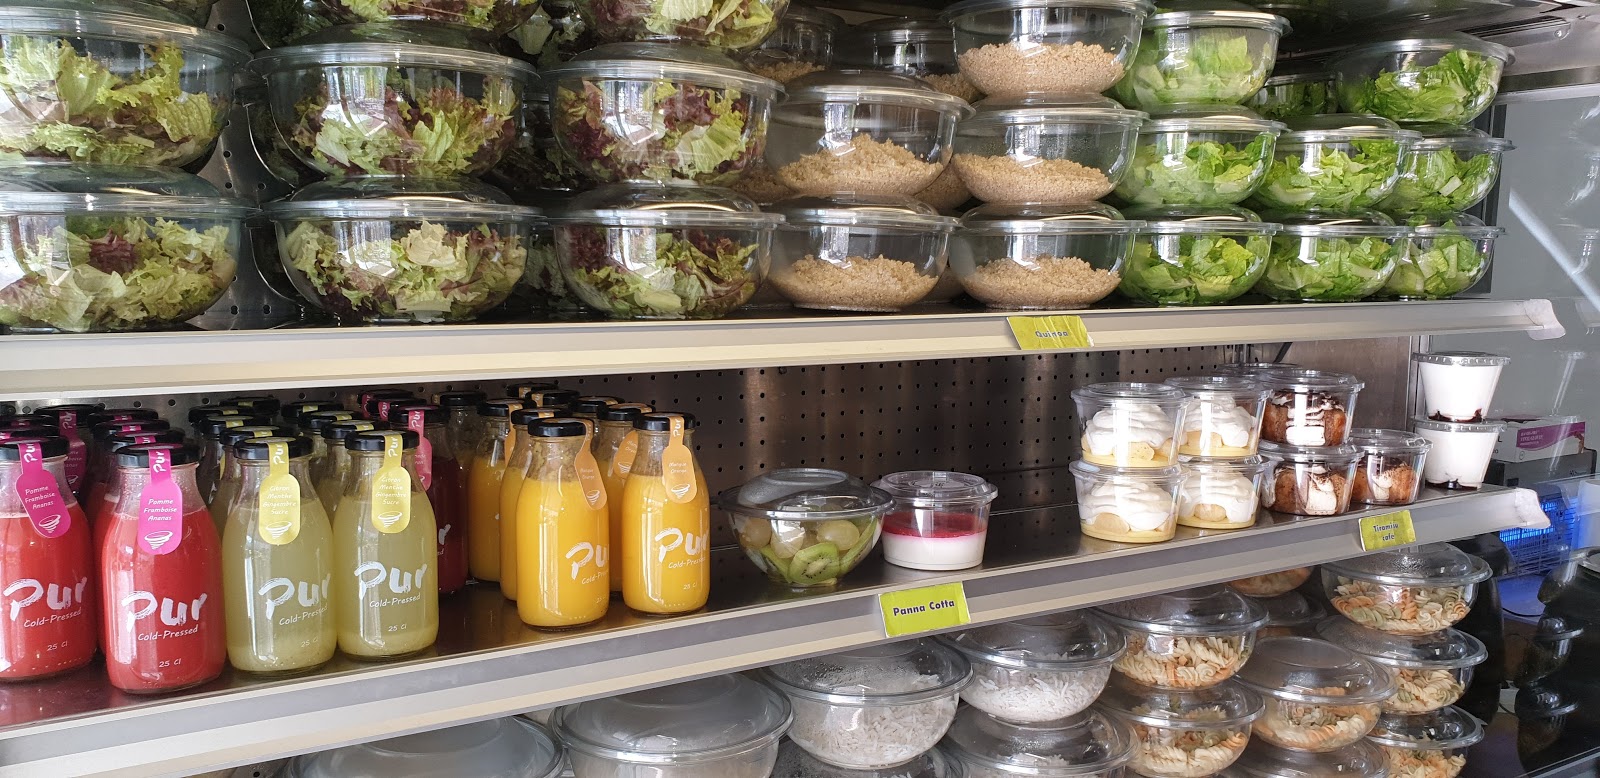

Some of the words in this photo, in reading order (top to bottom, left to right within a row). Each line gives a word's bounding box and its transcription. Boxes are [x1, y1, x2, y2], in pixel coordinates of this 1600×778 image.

[1035, 329, 1069, 339] Quinoa
[672, 418, 681, 438] Pur
[153, 451, 167, 474] Pur
[24, 492, 55, 504] Framboise
[25, 486, 49, 496] Pomme
[32, 501, 54, 510] Ananas
[143, 506, 178, 514] Framboise
[147, 498, 174, 506] Pomme
[147, 514, 172, 522] Ananas
[654, 527, 709, 563] Pur
[354, 561, 428, 600] Pur
[2, 576, 88, 622] Pur
[257, 573, 332, 621] Pur
[369, 592, 421, 609] Cold-Pressed
[121, 590, 208, 633] Pur
[278, 602, 328, 626] Cold-Pressed
[893, 603, 926, 617] Panna
[928, 598, 955, 611] Cotta
[23, 609, 82, 628] Cold-Pressed
[138, 624, 199, 642] Cold-Pressed
[387, 623, 398, 632] 25
[47, 643, 58, 652] 25
[159, 660, 170, 668] 25
